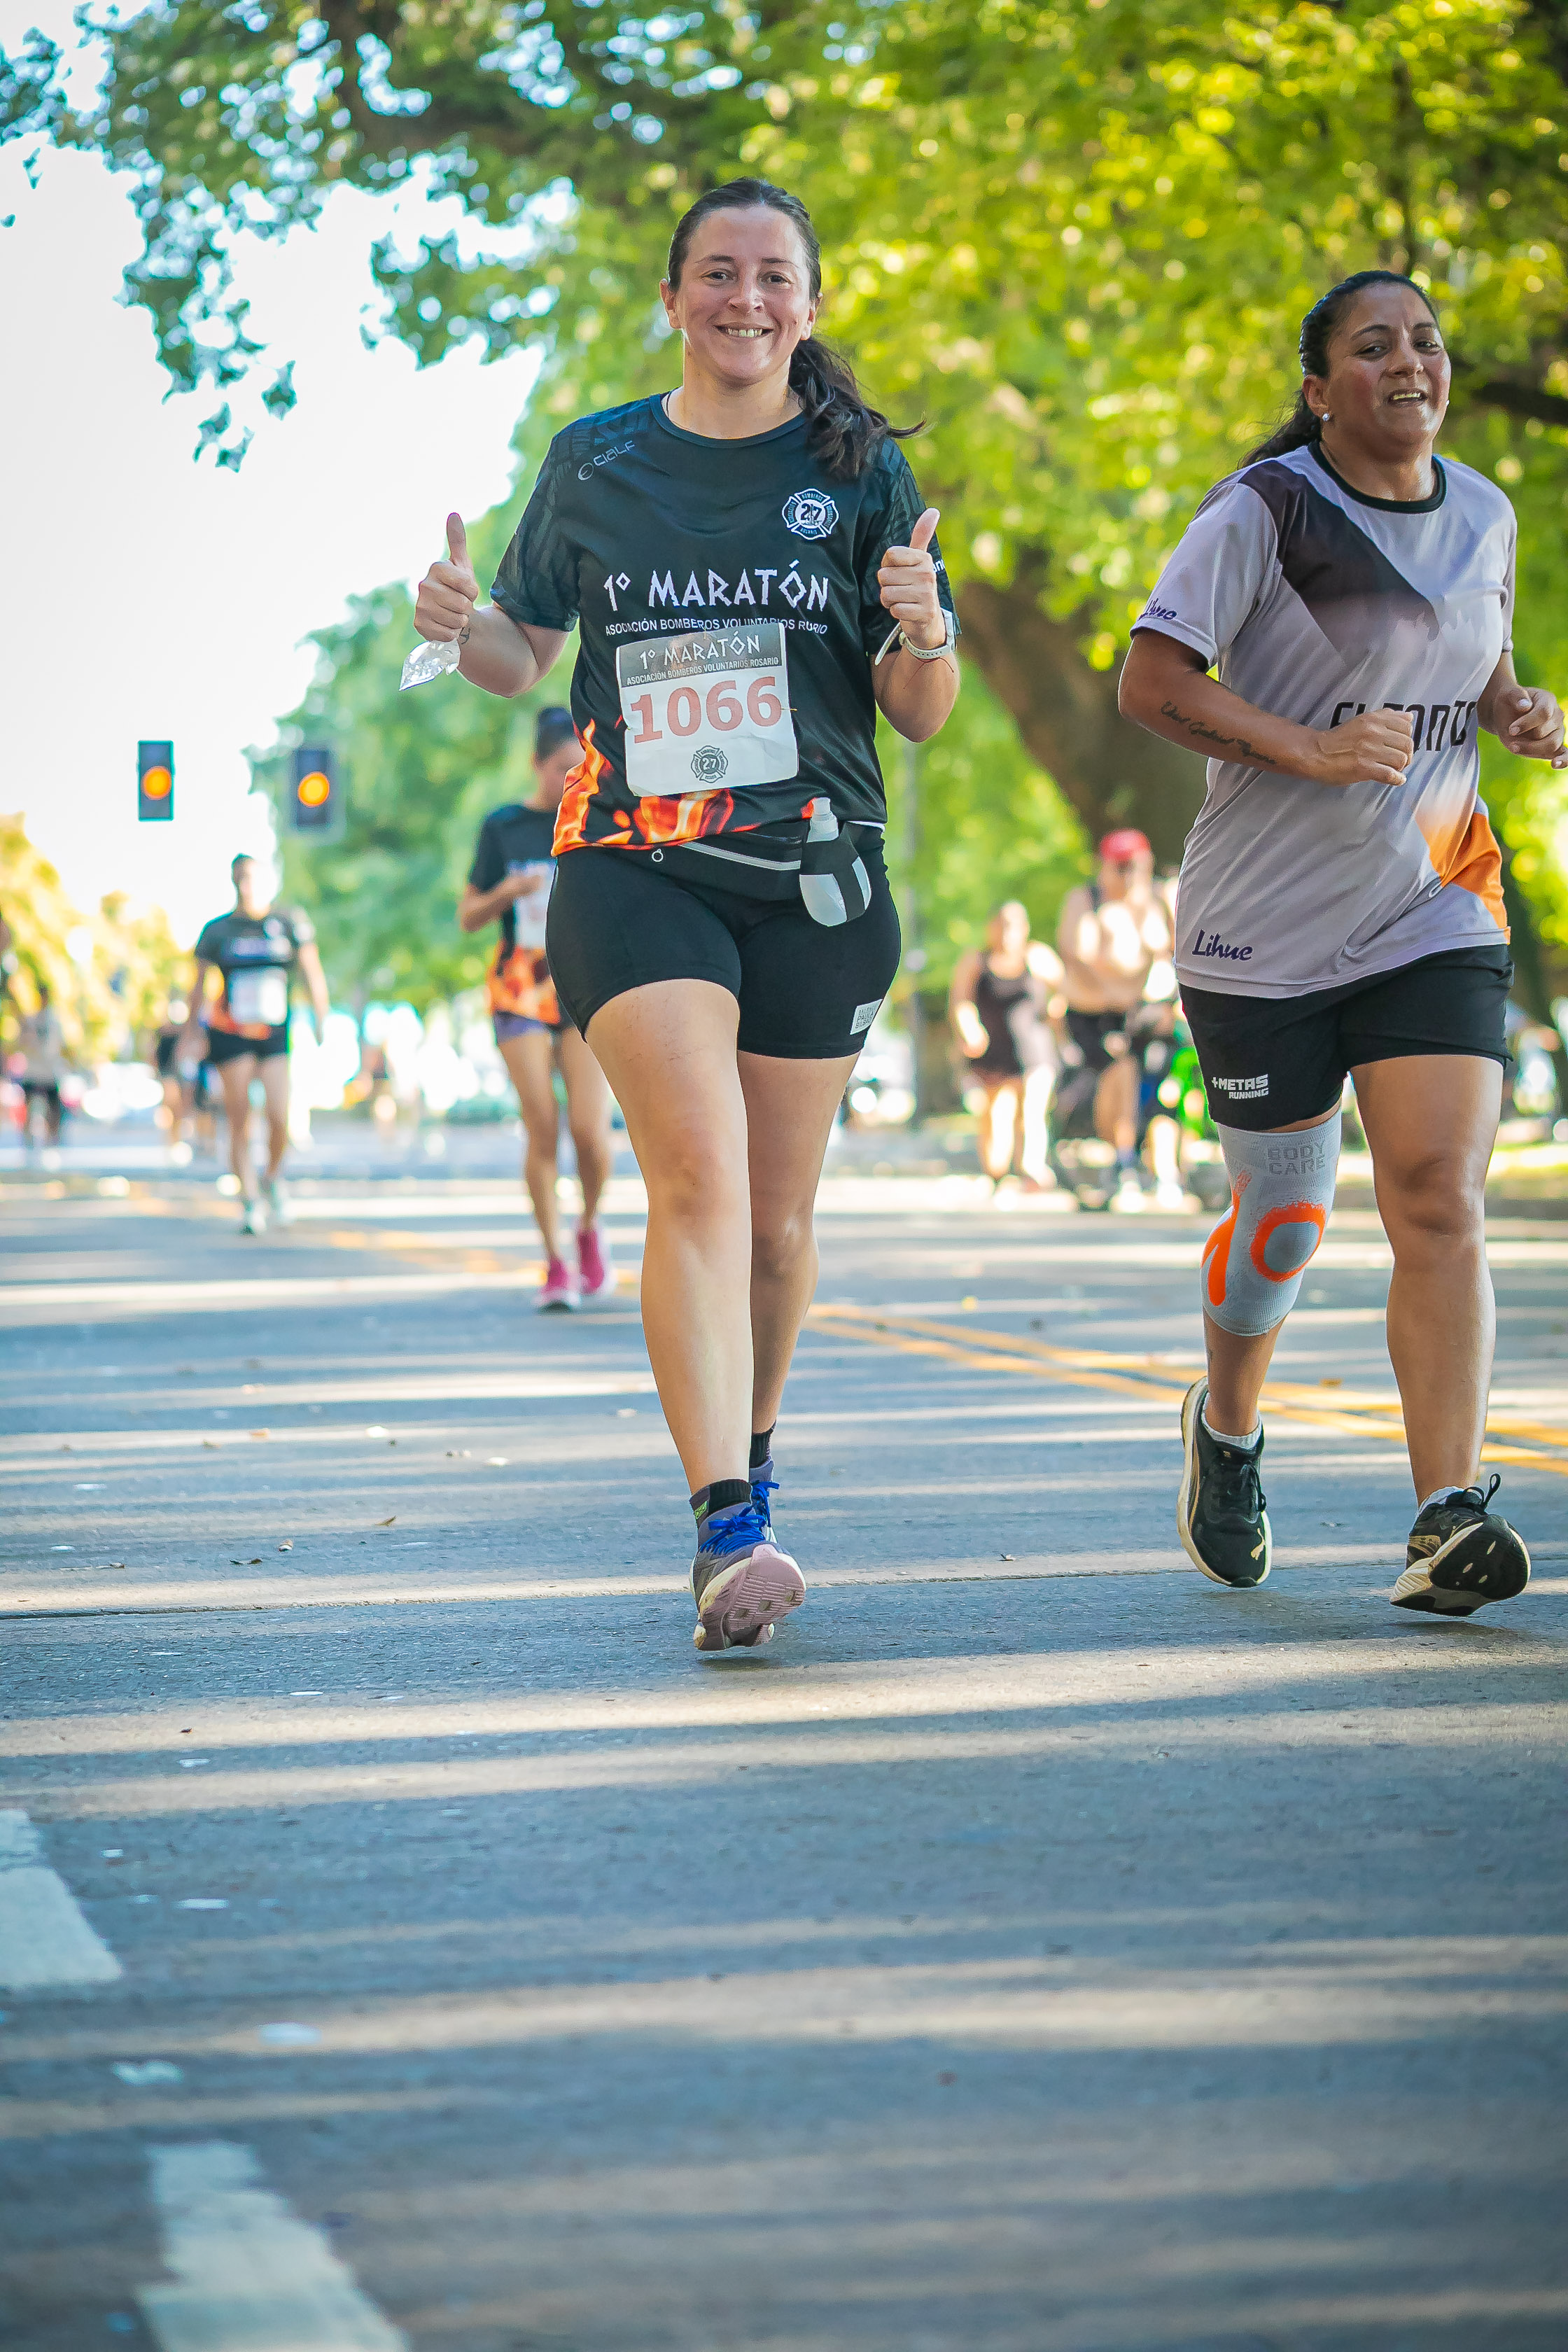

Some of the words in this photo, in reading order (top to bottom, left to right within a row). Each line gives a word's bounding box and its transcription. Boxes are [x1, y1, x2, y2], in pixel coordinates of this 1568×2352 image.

[801, 503, 822, 521] 27
[648, 559, 828, 611] MARATÓN
[660, 617, 720, 630] BOMBEROS
[663, 630, 761, 666] MARATÓN
[626, 671, 666, 686] ASOCIACIÓN
[667, 665, 702, 678] BOMBEROS
[703, 660, 748, 672] VOLUNTARIOS
[750, 657, 779, 667] ROSARIO
[630, 676, 782, 744] 1066
[702, 757, 717, 771] 27
[1191, 929, 1253, 961] Lihue
[1228, 1087, 1269, 1100] RUNNING
[1267, 1140, 1325, 1159] BODY
[1268, 1156, 1326, 1175] CARE
